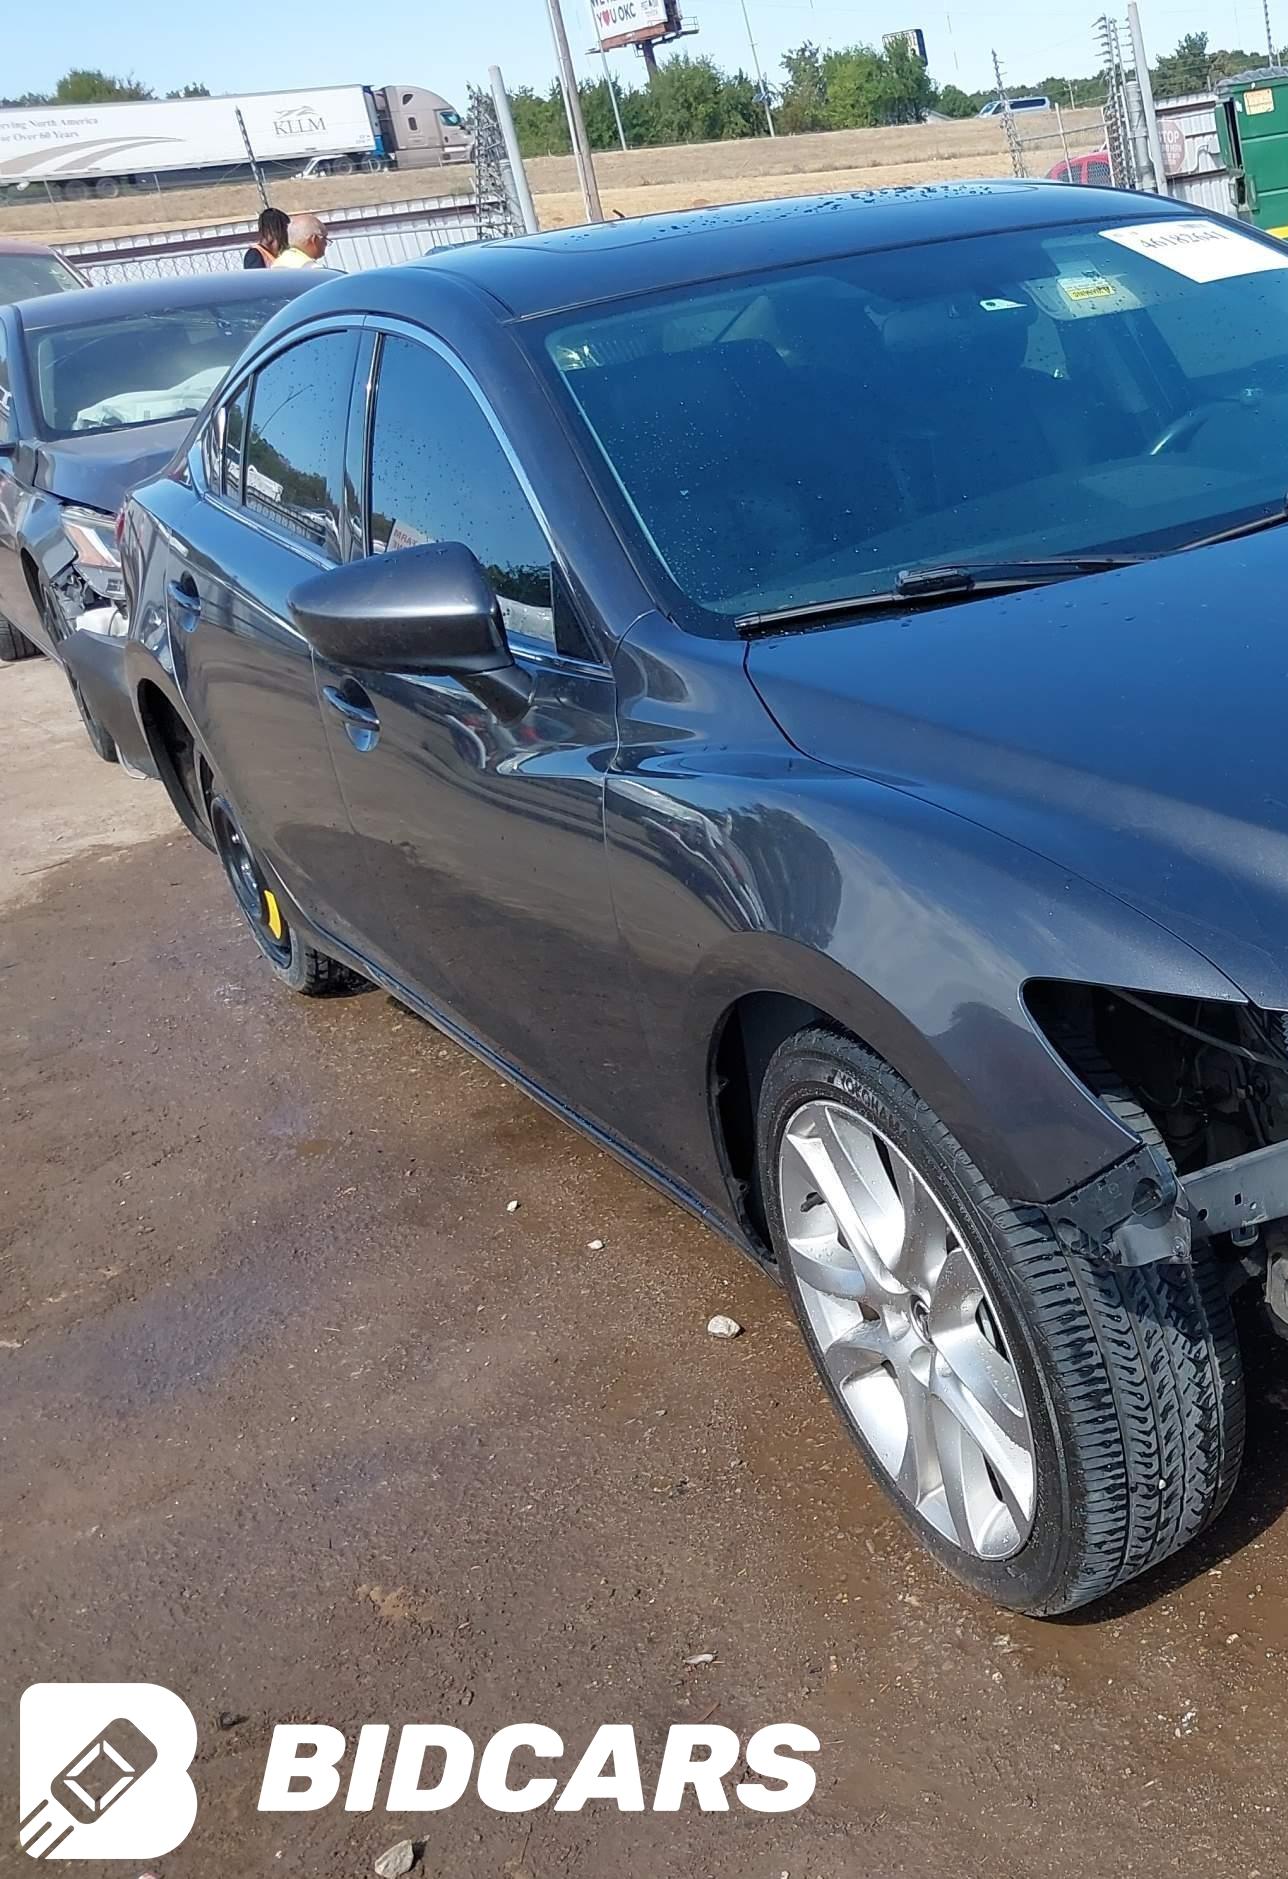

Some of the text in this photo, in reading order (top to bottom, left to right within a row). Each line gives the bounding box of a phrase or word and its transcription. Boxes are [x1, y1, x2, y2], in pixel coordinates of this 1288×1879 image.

[617, 2, 636, 21] OKC
[29, 119, 57, 127] North
[61, 117, 98, 126] America
[273, 117, 327, 135] KLLM
[52, 130, 79, 139] Years
